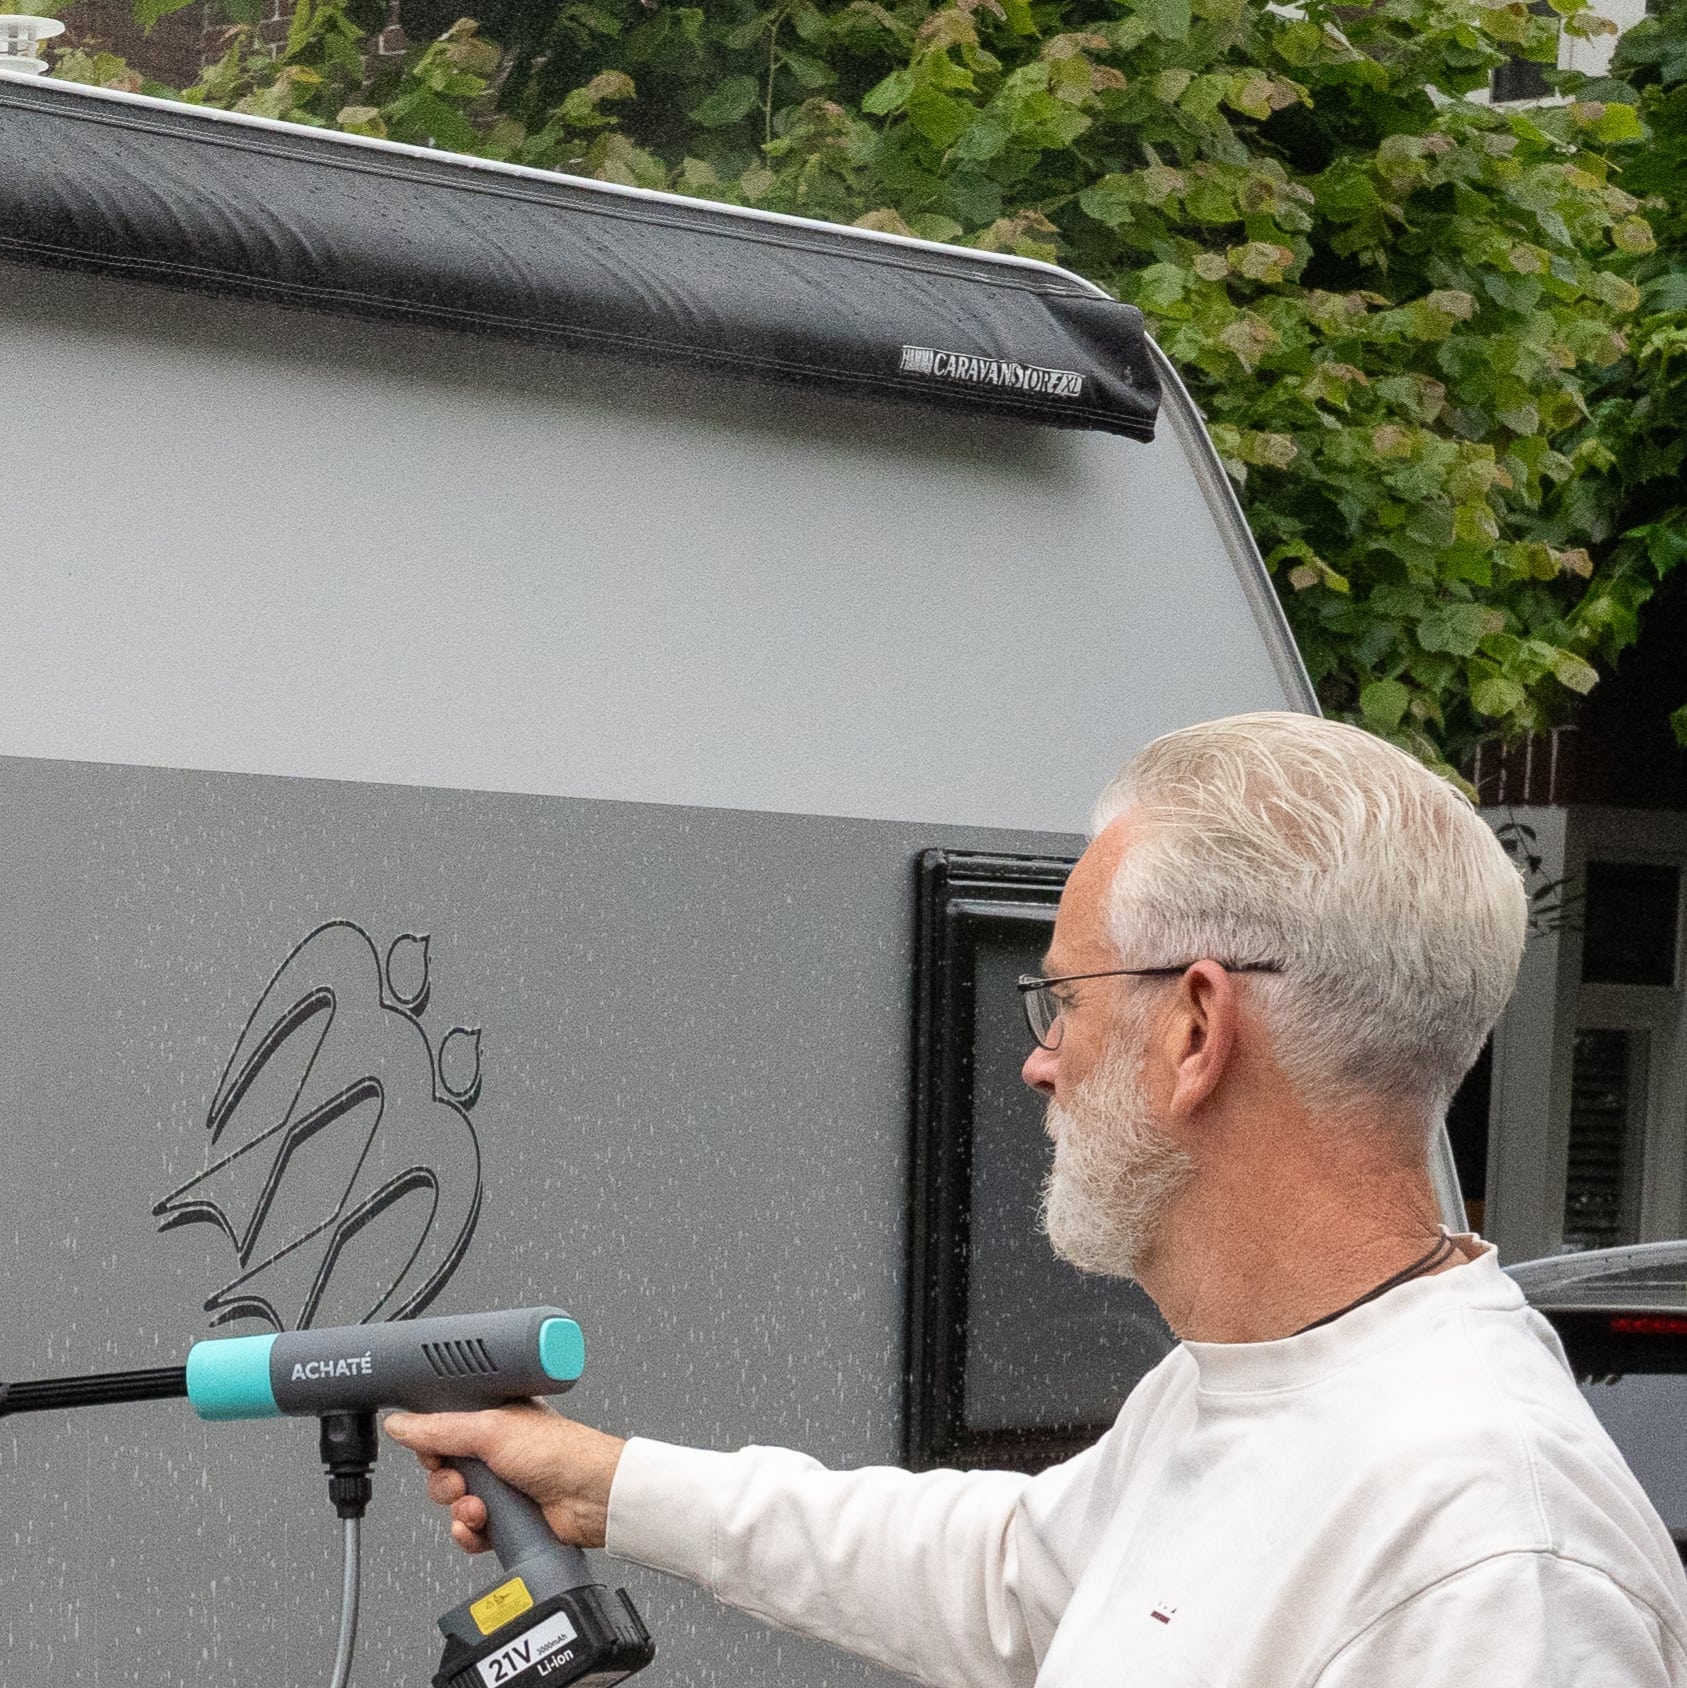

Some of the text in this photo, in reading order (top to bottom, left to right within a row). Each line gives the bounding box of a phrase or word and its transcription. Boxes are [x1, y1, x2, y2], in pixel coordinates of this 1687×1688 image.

[934, 352, 1059, 394] CARAVANSTORE
[1063, 375, 1081, 395] XL
[291, 1351, 373, 1381] ACHATÉ
[489, 1639, 531, 1682] 21V
